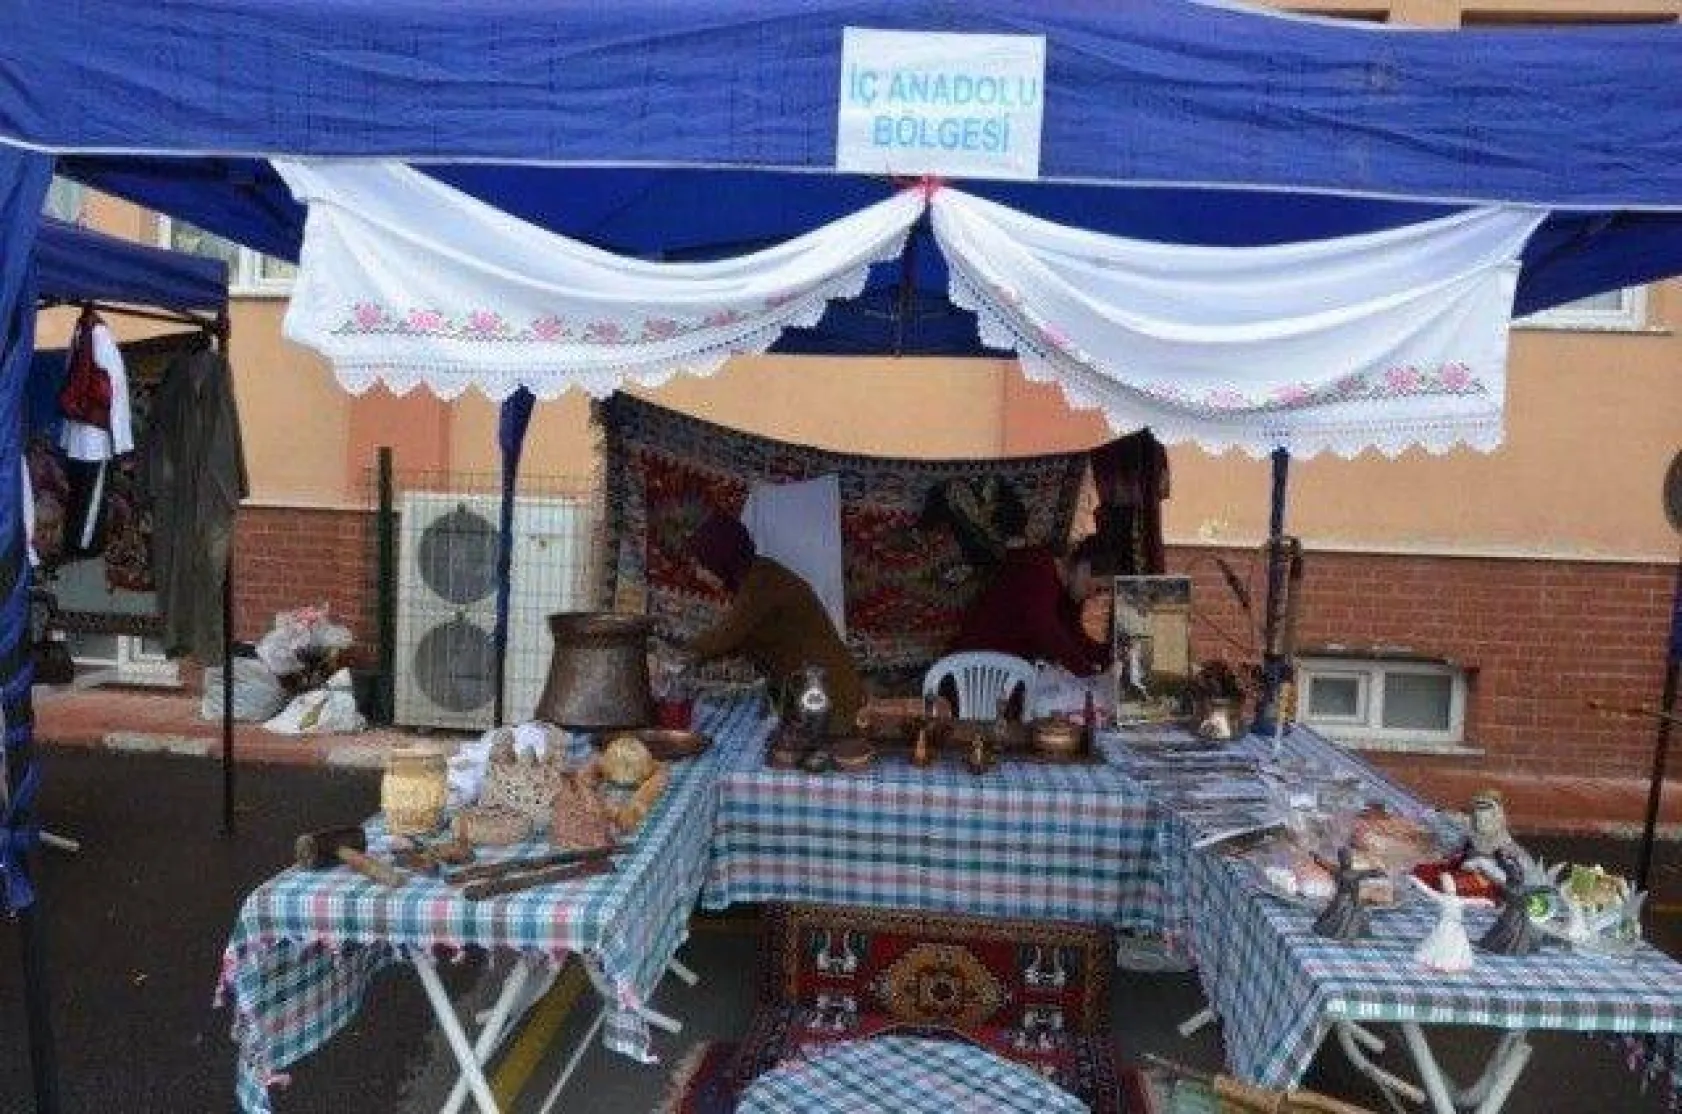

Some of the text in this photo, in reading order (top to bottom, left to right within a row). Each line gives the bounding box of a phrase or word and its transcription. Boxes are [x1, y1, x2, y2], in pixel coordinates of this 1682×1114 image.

[850, 64, 1036, 106] İÇ ANADOLU
[872, 110, 1010, 152] BÖLGESİ
